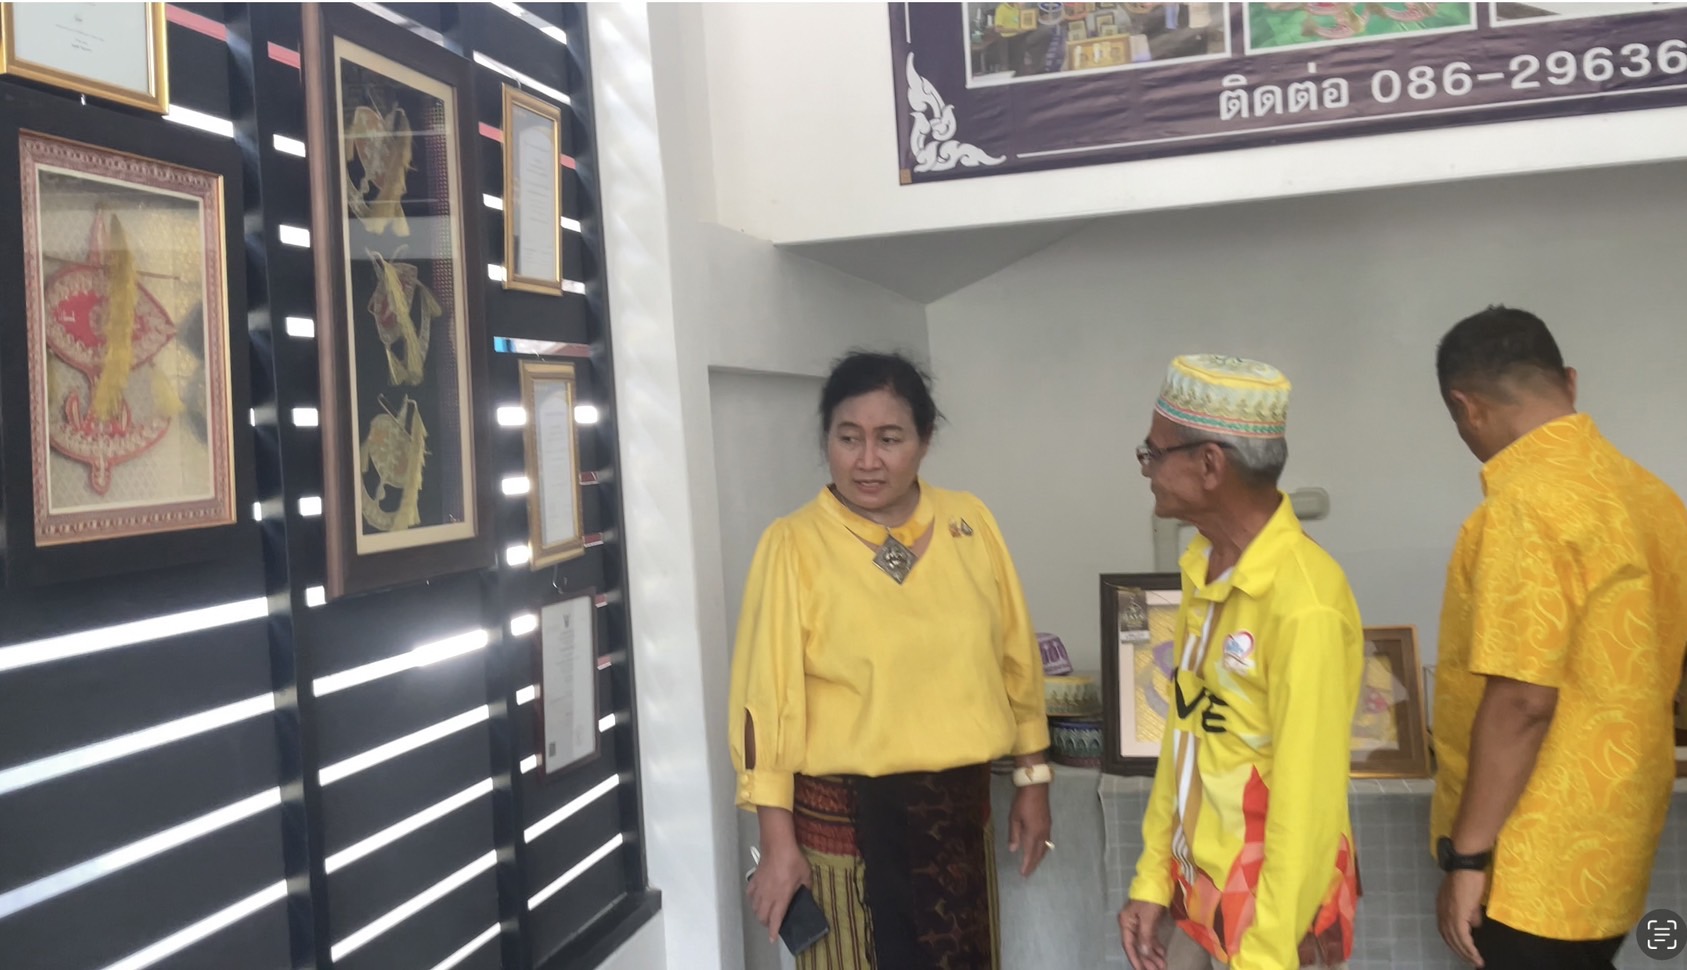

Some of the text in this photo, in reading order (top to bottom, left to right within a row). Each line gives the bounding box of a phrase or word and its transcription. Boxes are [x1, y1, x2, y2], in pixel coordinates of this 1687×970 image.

[1219, 39, 1687, 120] ติดต่อ 086-29636
